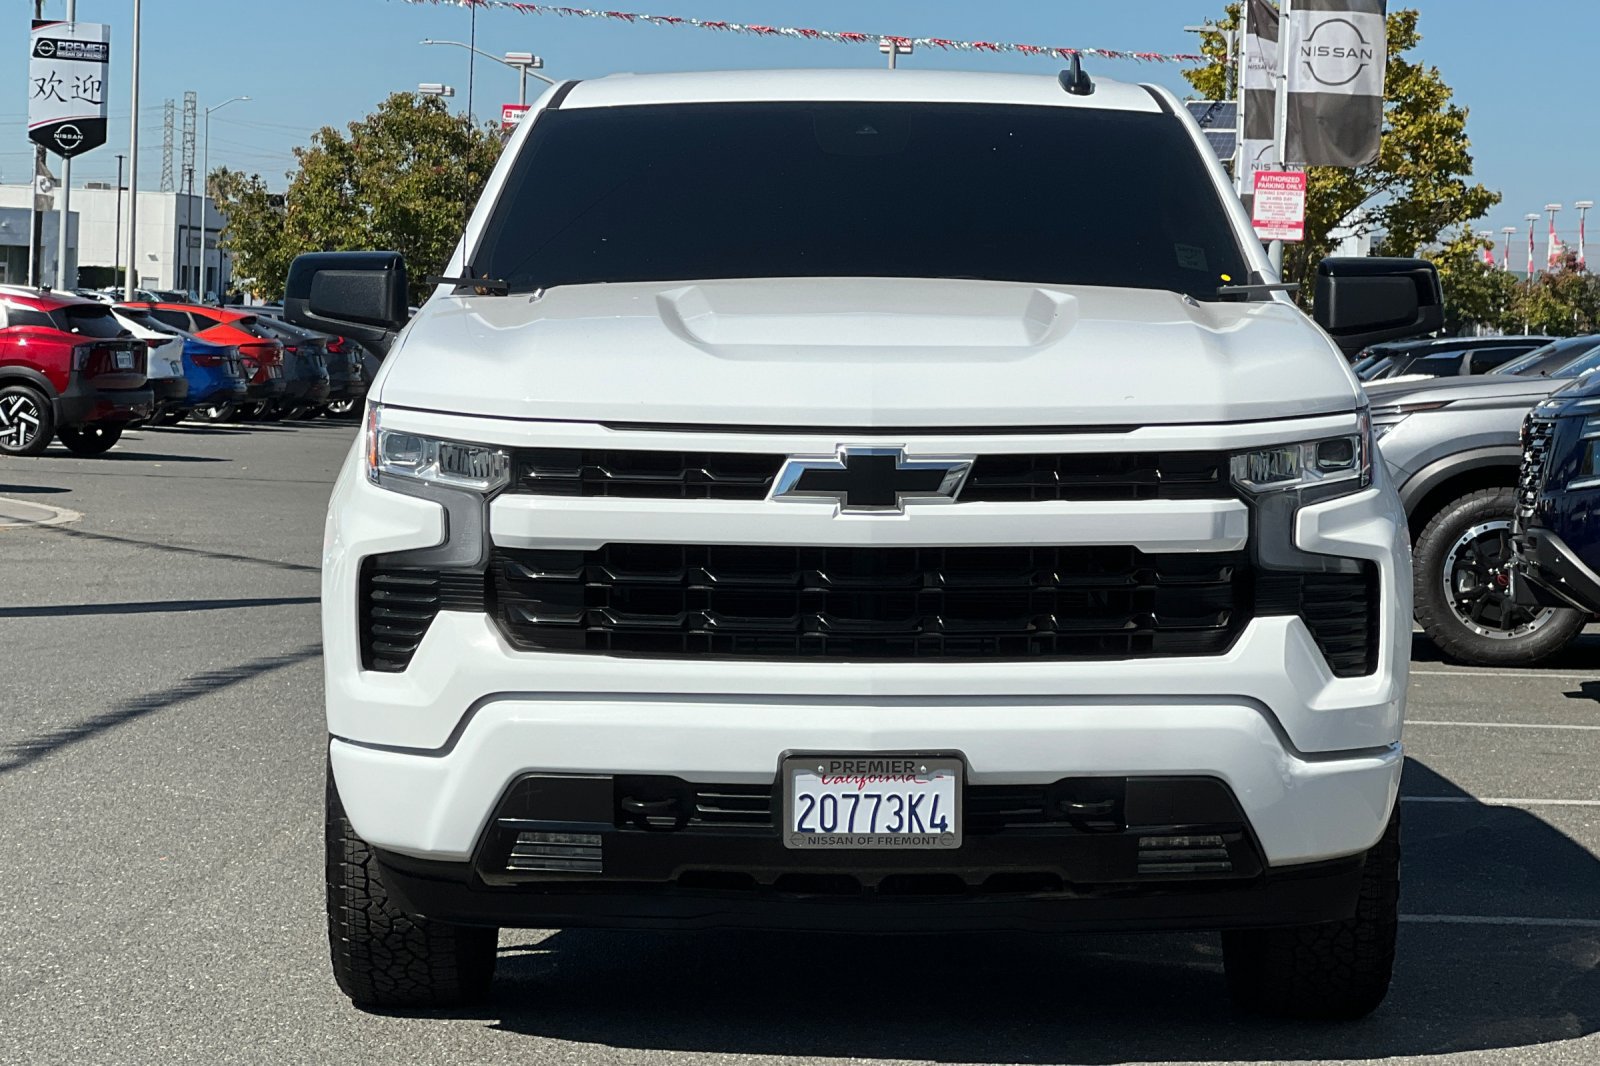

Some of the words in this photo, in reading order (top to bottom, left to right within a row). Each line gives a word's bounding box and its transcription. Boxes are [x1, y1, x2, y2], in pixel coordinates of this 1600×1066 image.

[57, 41, 107, 52] PREMIER
[1300, 46, 1373, 60] NISSAN
[33, 70, 104, 105] 欢迎
[1260, 175, 1300, 183] AUTHORIZED
[829, 760, 916, 774] PREMIER
[796, 793, 949, 834] 20773K4
[807, 836, 856, 846] NISSAN
[857, 836, 874, 846] OF
[877, 836, 938, 846] FREMONT
